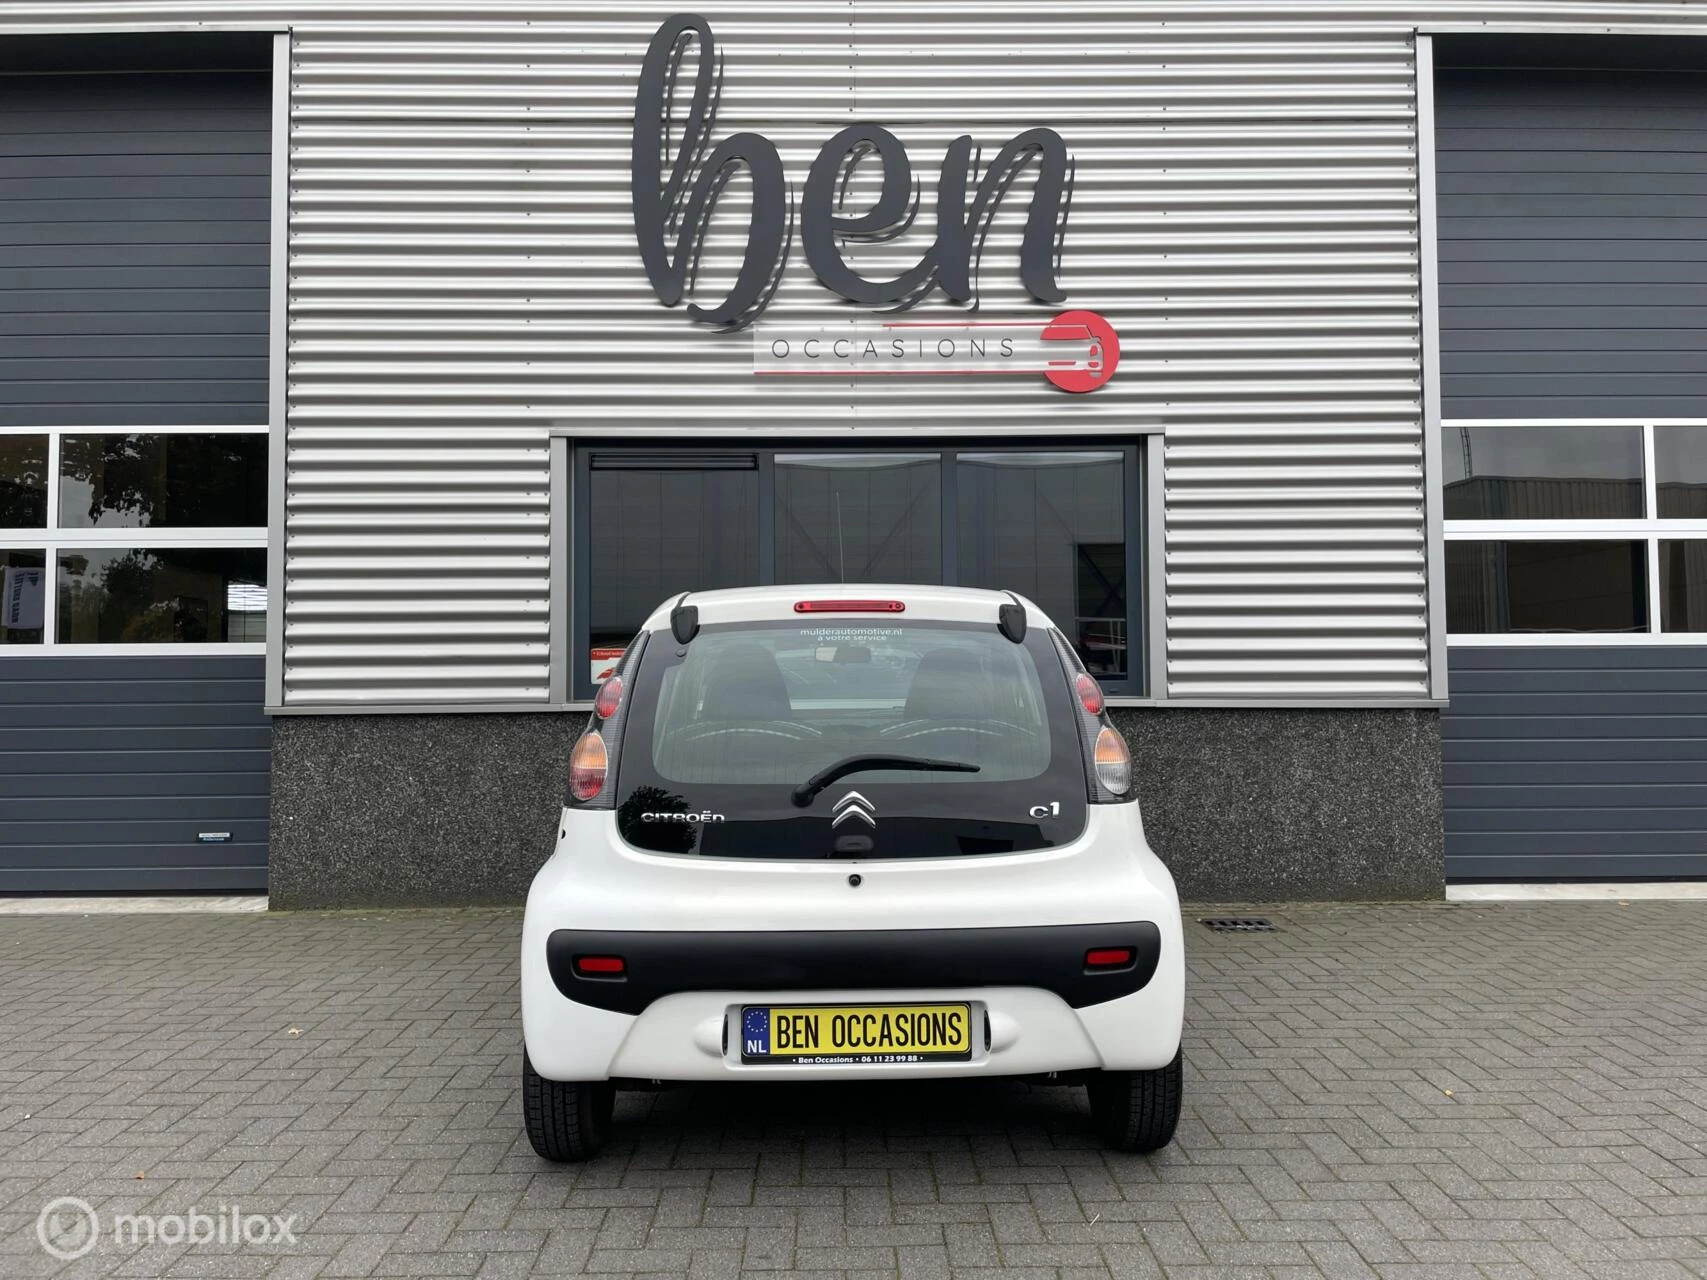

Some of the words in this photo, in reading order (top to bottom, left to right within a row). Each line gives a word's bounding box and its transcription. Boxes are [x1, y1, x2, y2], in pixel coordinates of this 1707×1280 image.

[632, 13, 1071, 326] ben
[771, 338, 1015, 360] OCCASIONS
[800, 628, 903, 636] mulderautomotive.nl
[1030, 801, 1060, 818] C1
[776, 1015, 819, 1049] BEN
[832, 1012, 962, 1048] OCCASIONS
[747, 1040, 767, 1054] NL
[815, 1056, 853, 1064] Occasions
